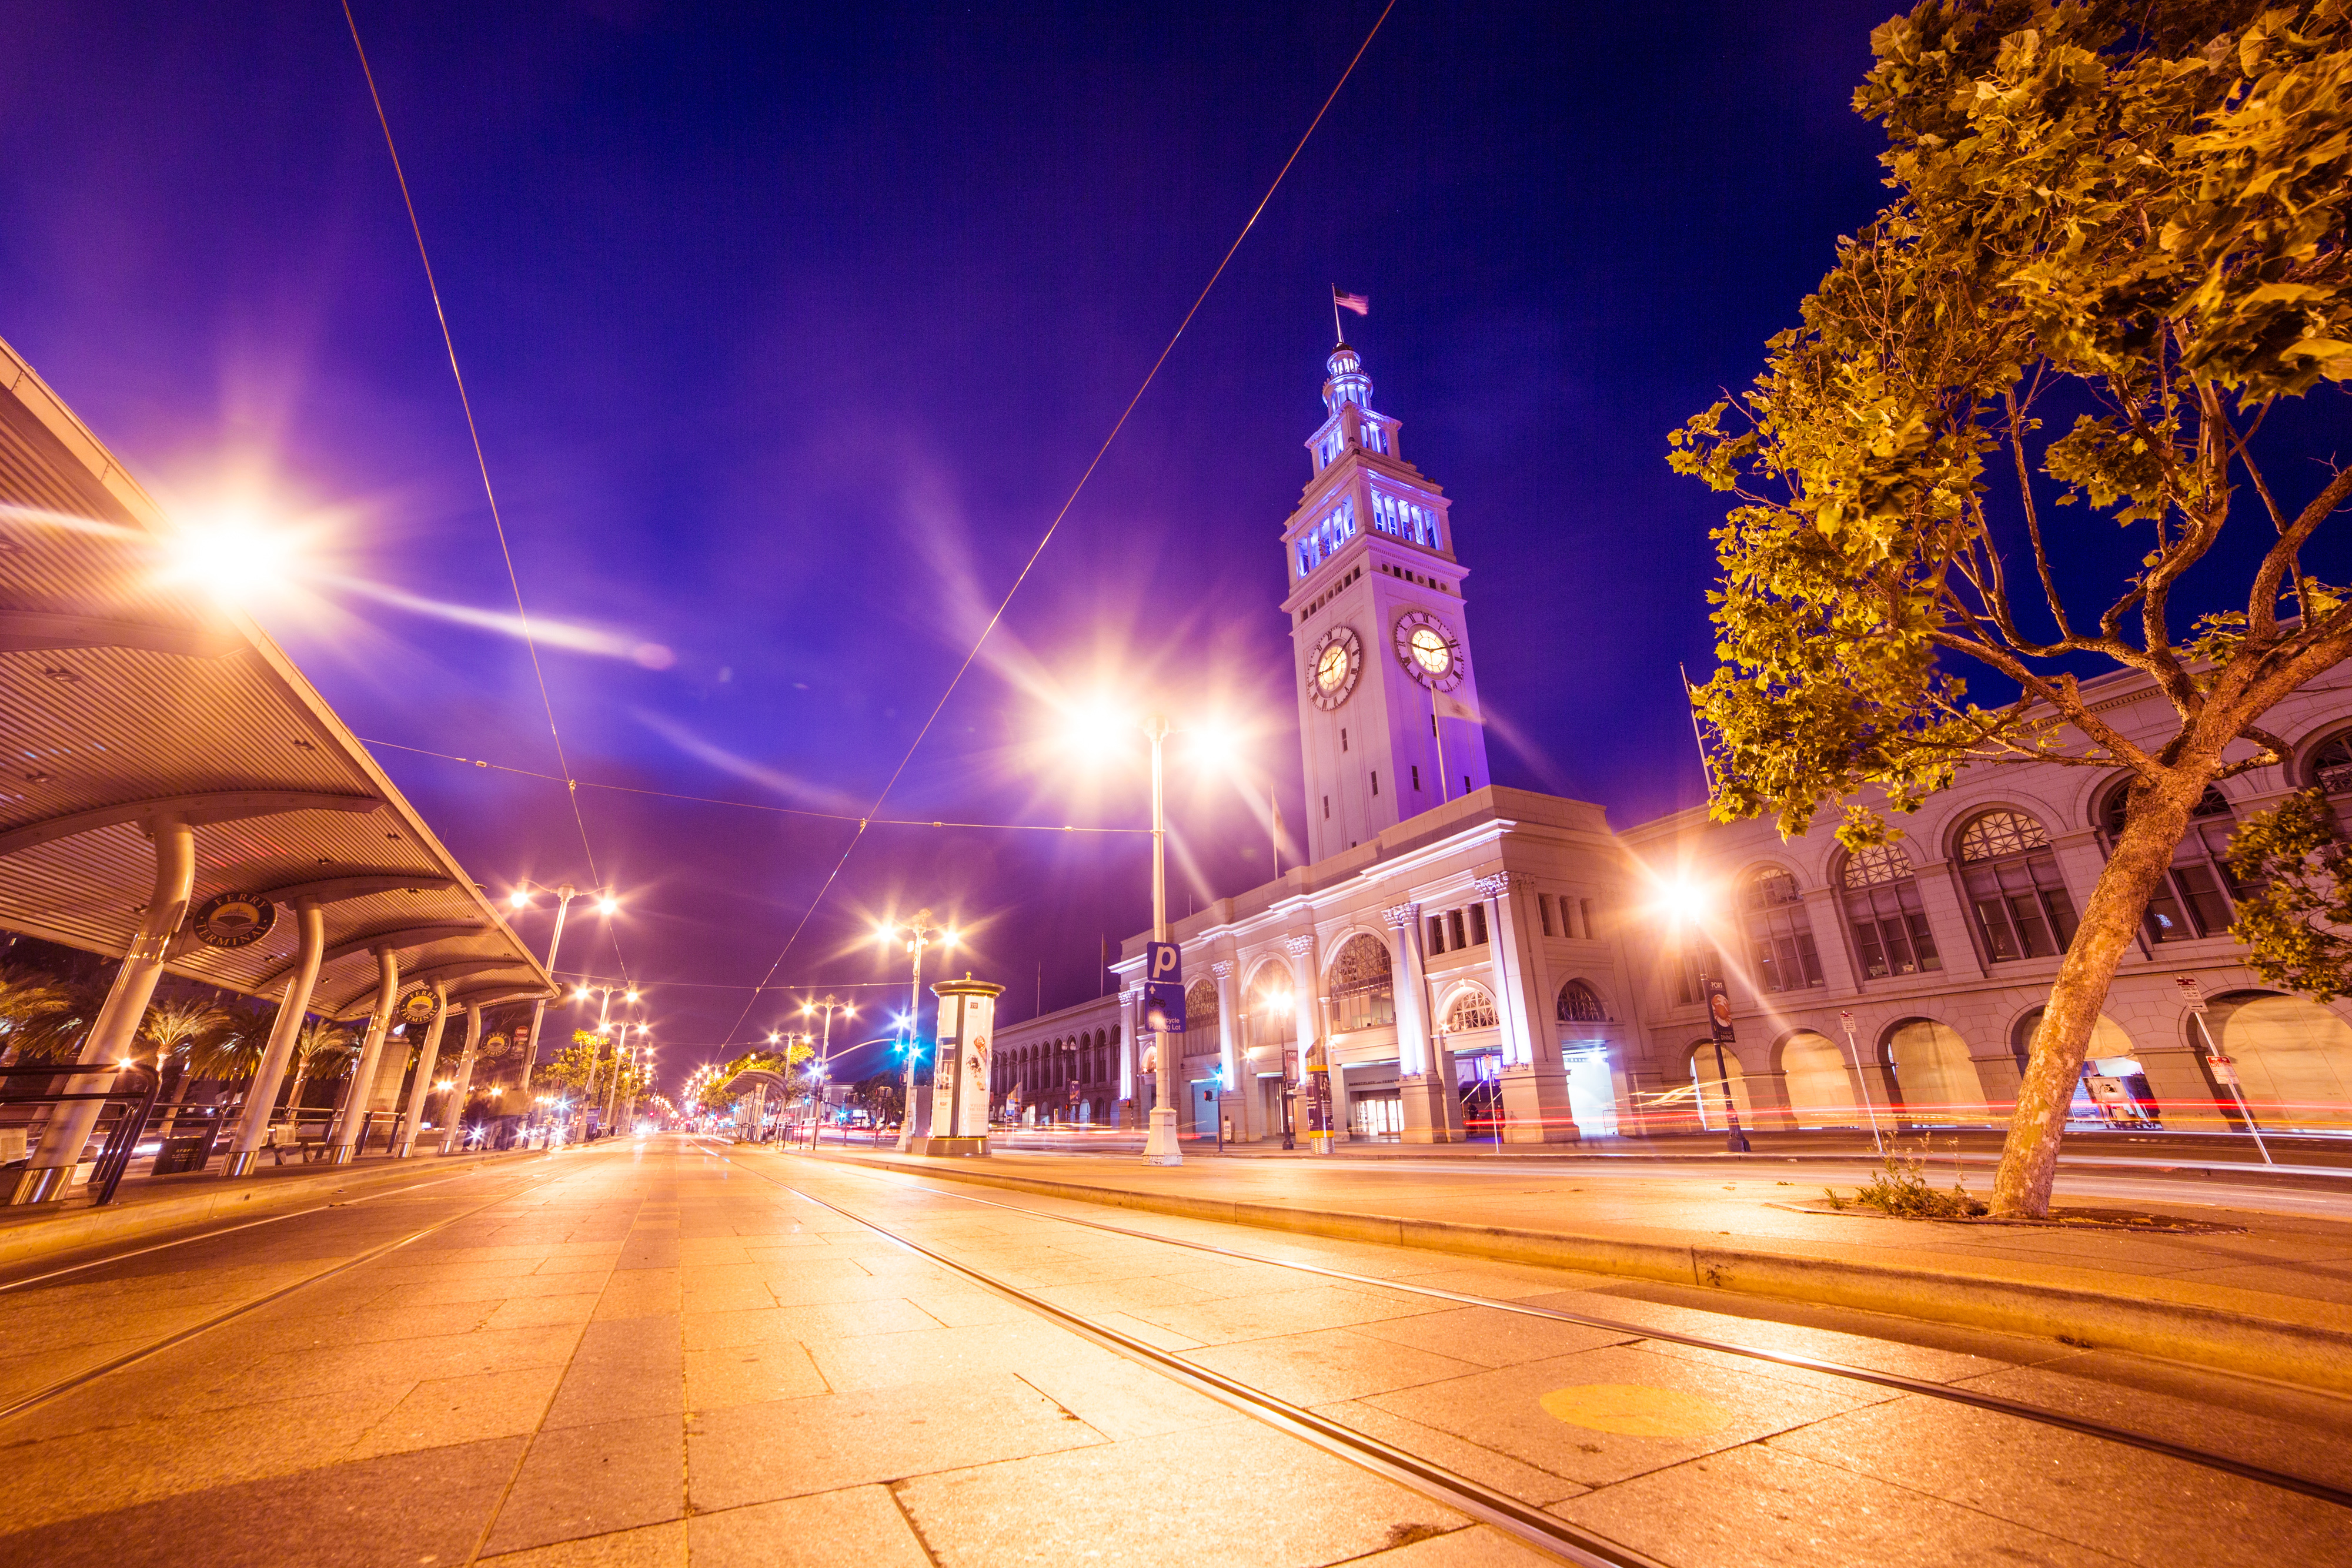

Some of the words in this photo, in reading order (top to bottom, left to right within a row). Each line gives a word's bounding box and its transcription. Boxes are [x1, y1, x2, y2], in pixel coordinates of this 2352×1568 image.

[214, 894, 268, 908] FERRY
[196, 922, 268, 946] TERMINAL
[409, 990, 437, 999] FERRY
[400, 1008, 438, 1022] TERMINAL
[483, 1045, 508, 1055] TERMINAL
